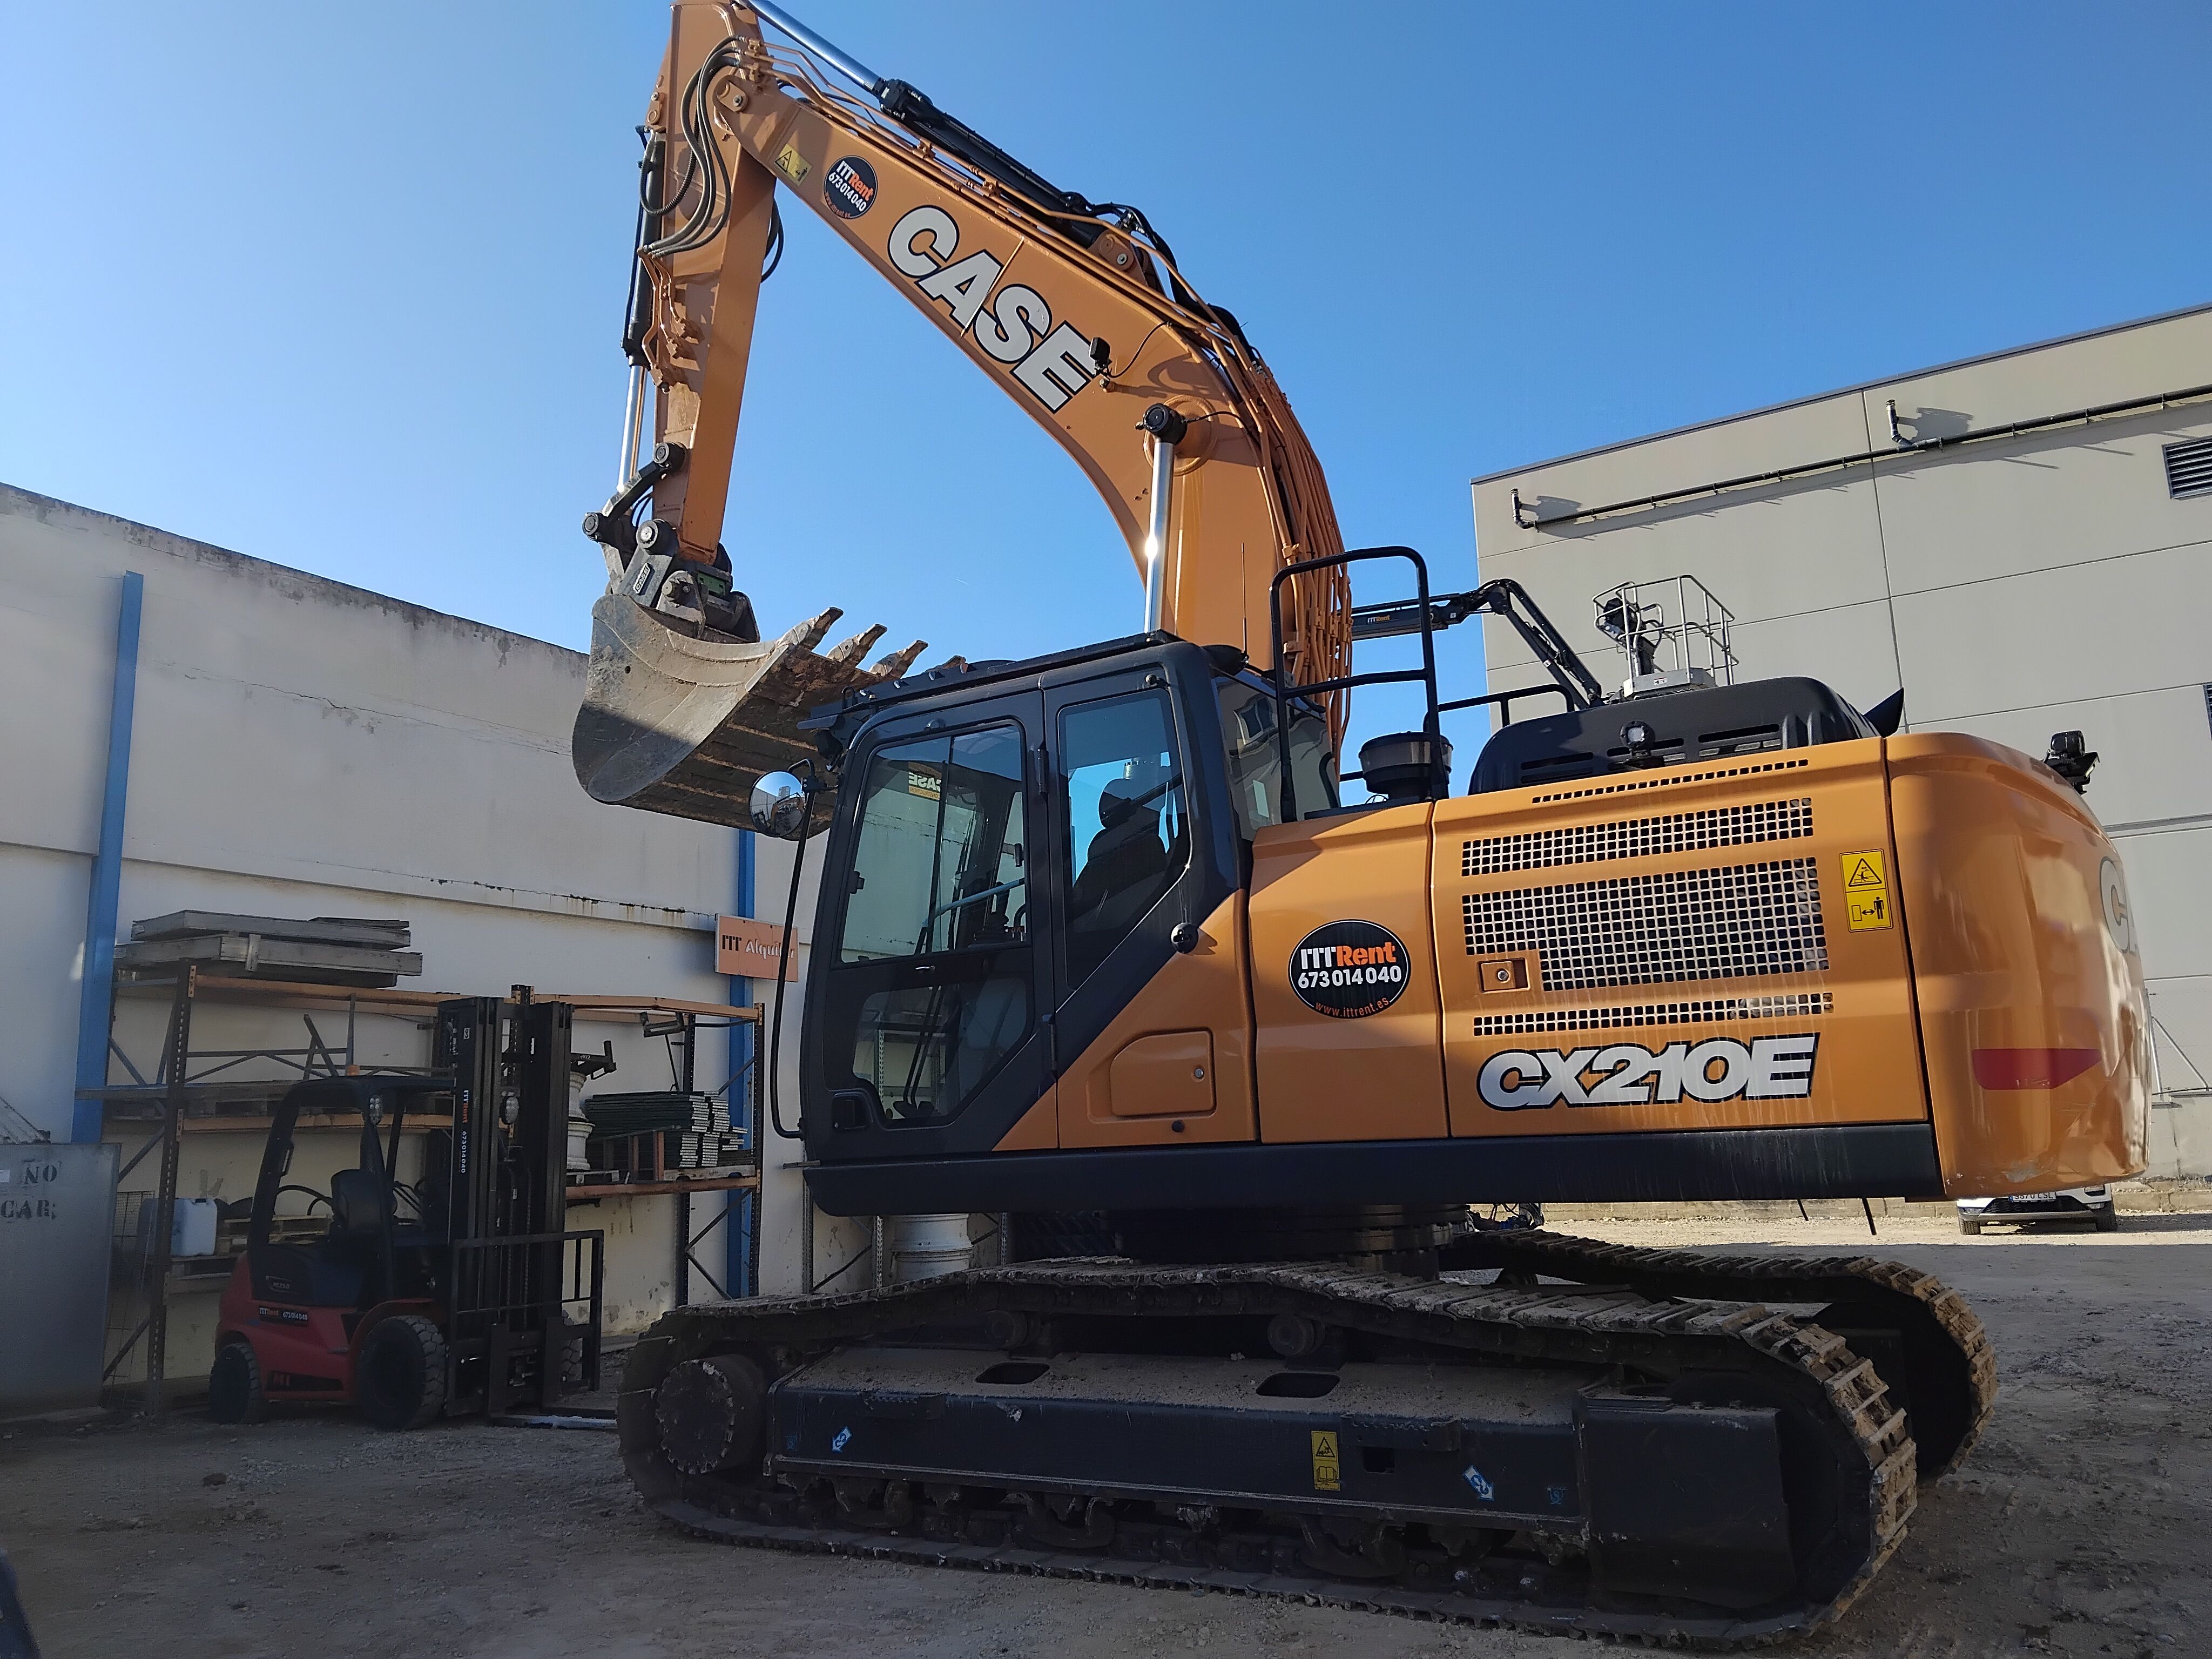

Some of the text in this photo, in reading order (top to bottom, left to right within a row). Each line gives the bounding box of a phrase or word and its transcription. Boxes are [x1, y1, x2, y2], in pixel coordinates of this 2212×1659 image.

[887, 205, 1095, 414] CASE
[745, 939, 795, 959] Alquilr
[1316, 997, 1390, 1017] www.ittrent.es
[1476, 1032, 1820, 1111] CX210E
[24, 1165, 58, 1184] NO
